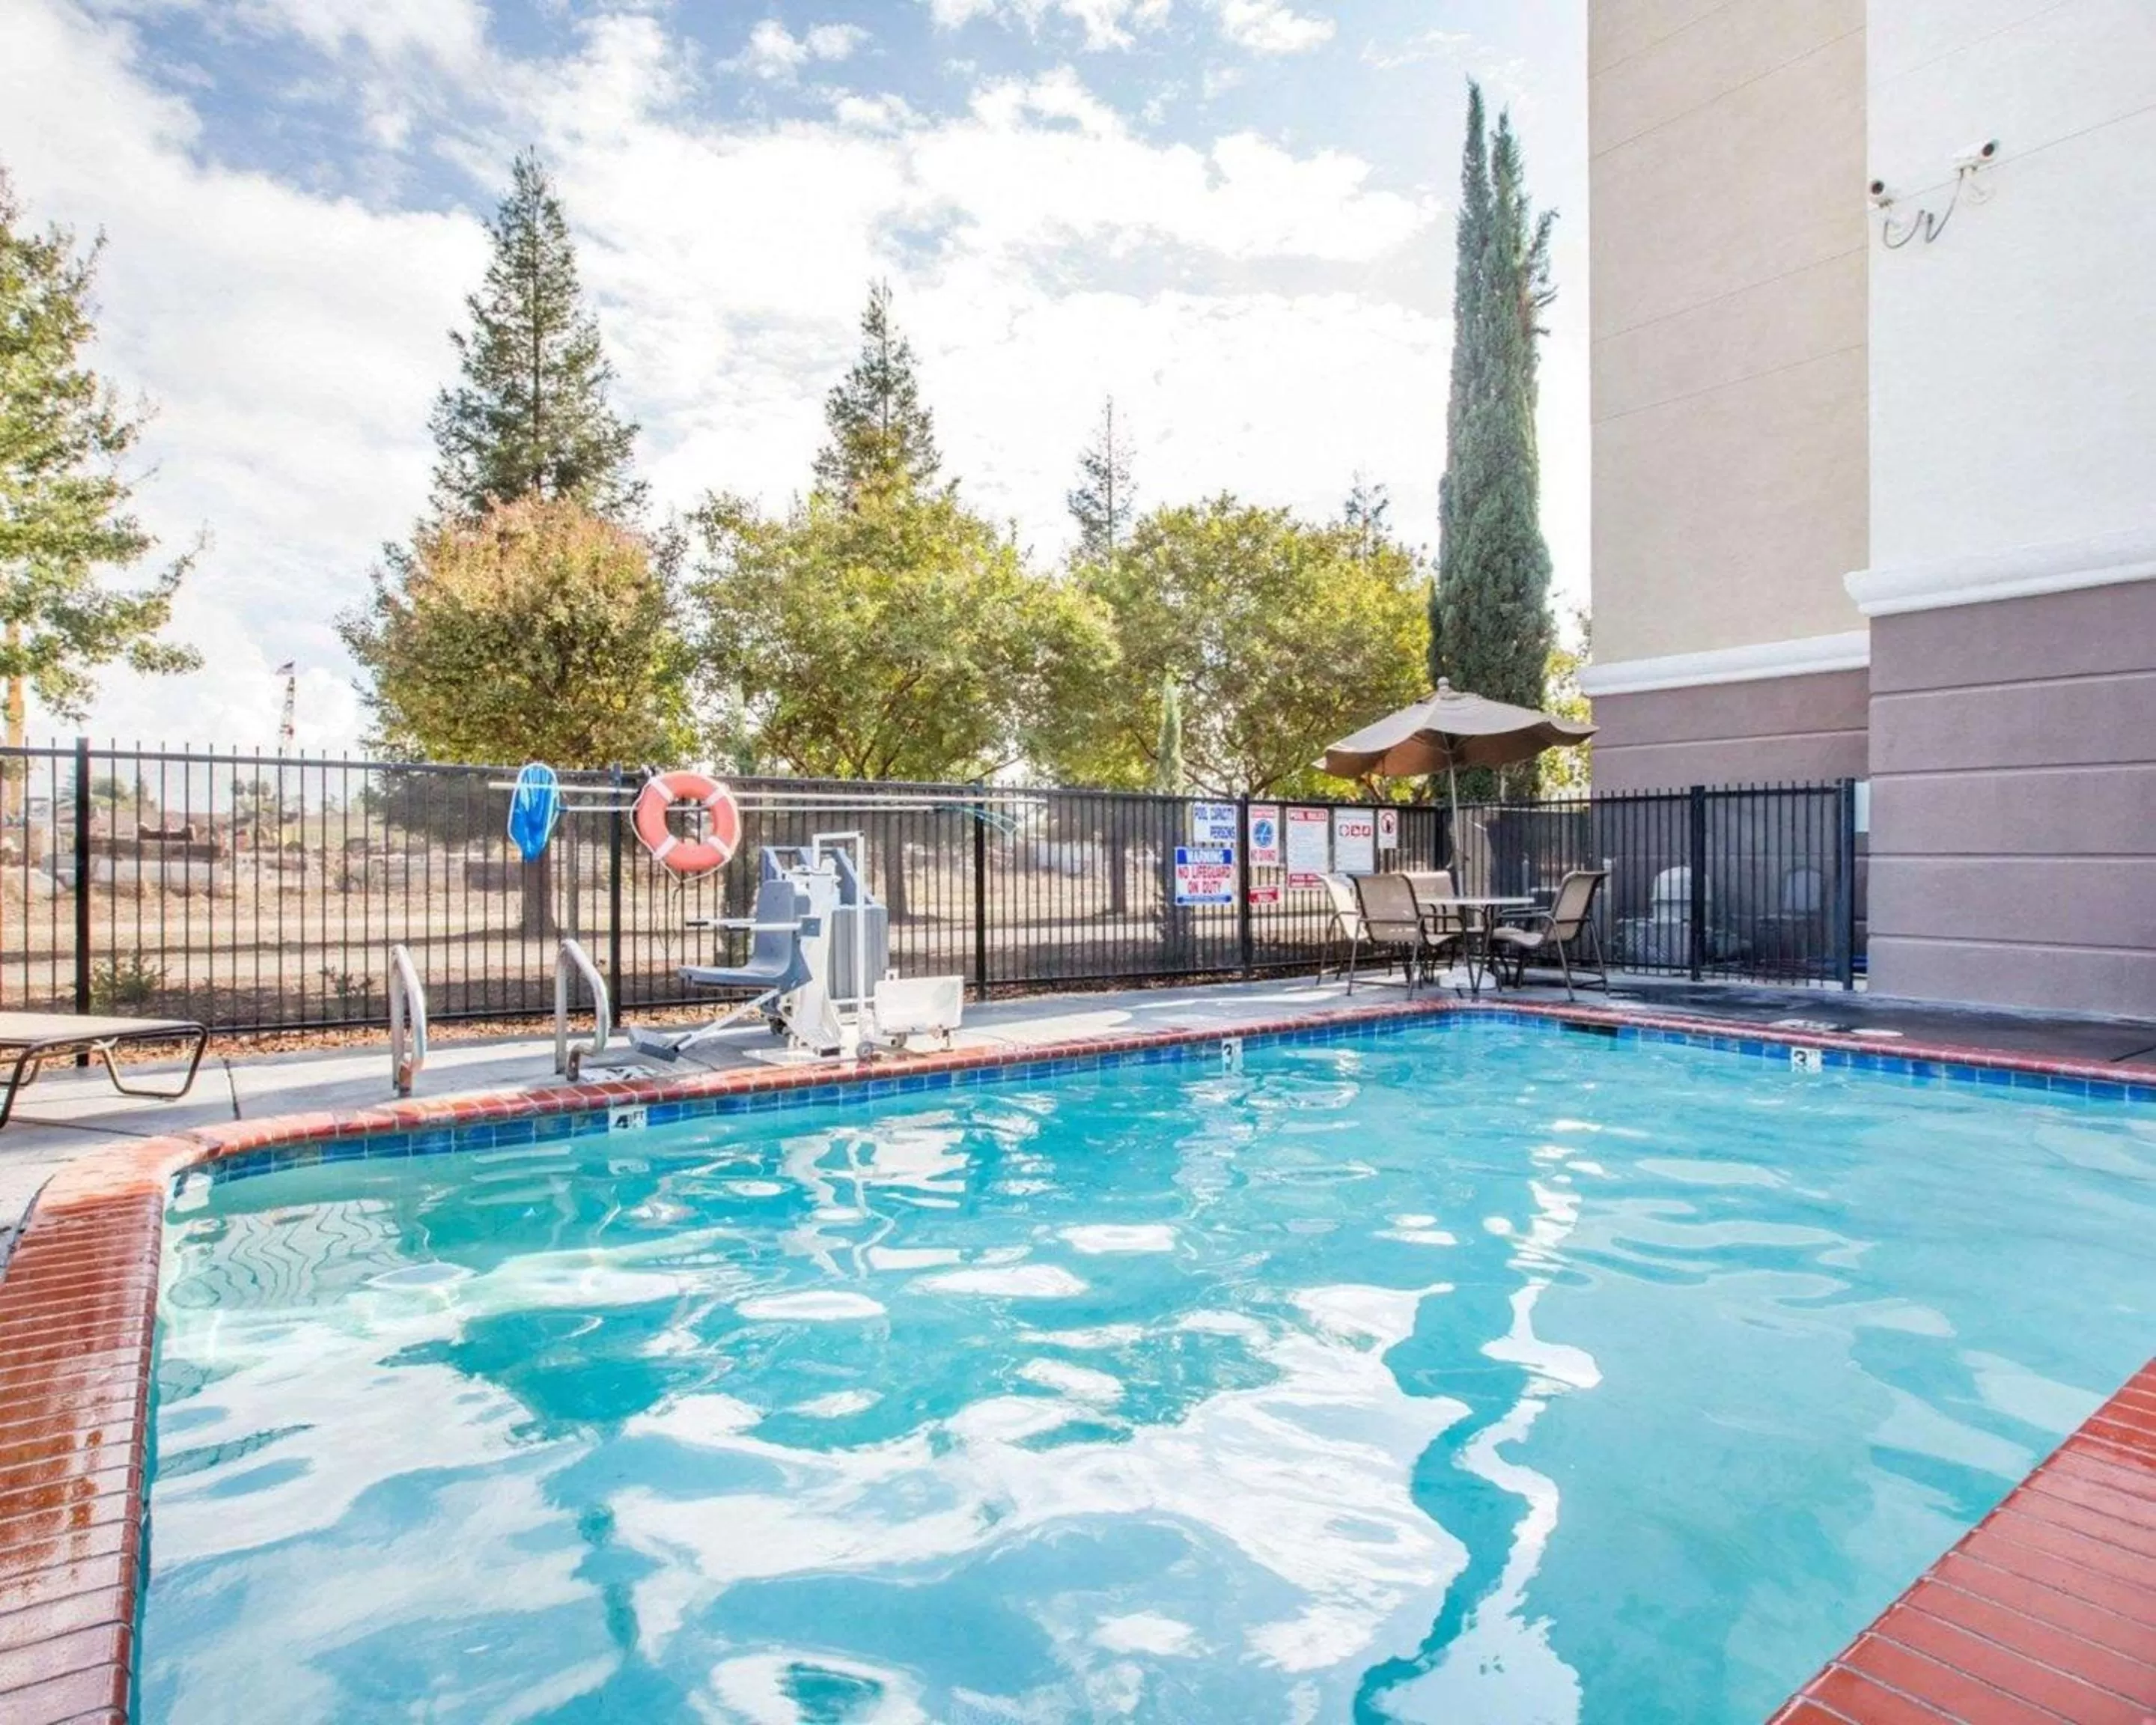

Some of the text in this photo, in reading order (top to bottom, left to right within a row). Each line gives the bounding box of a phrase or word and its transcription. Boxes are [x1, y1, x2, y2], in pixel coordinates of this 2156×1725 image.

[1178, 865, 1231, 879] NO LIFEGUARD
[1189, 880, 1222, 894] ON DUTY
